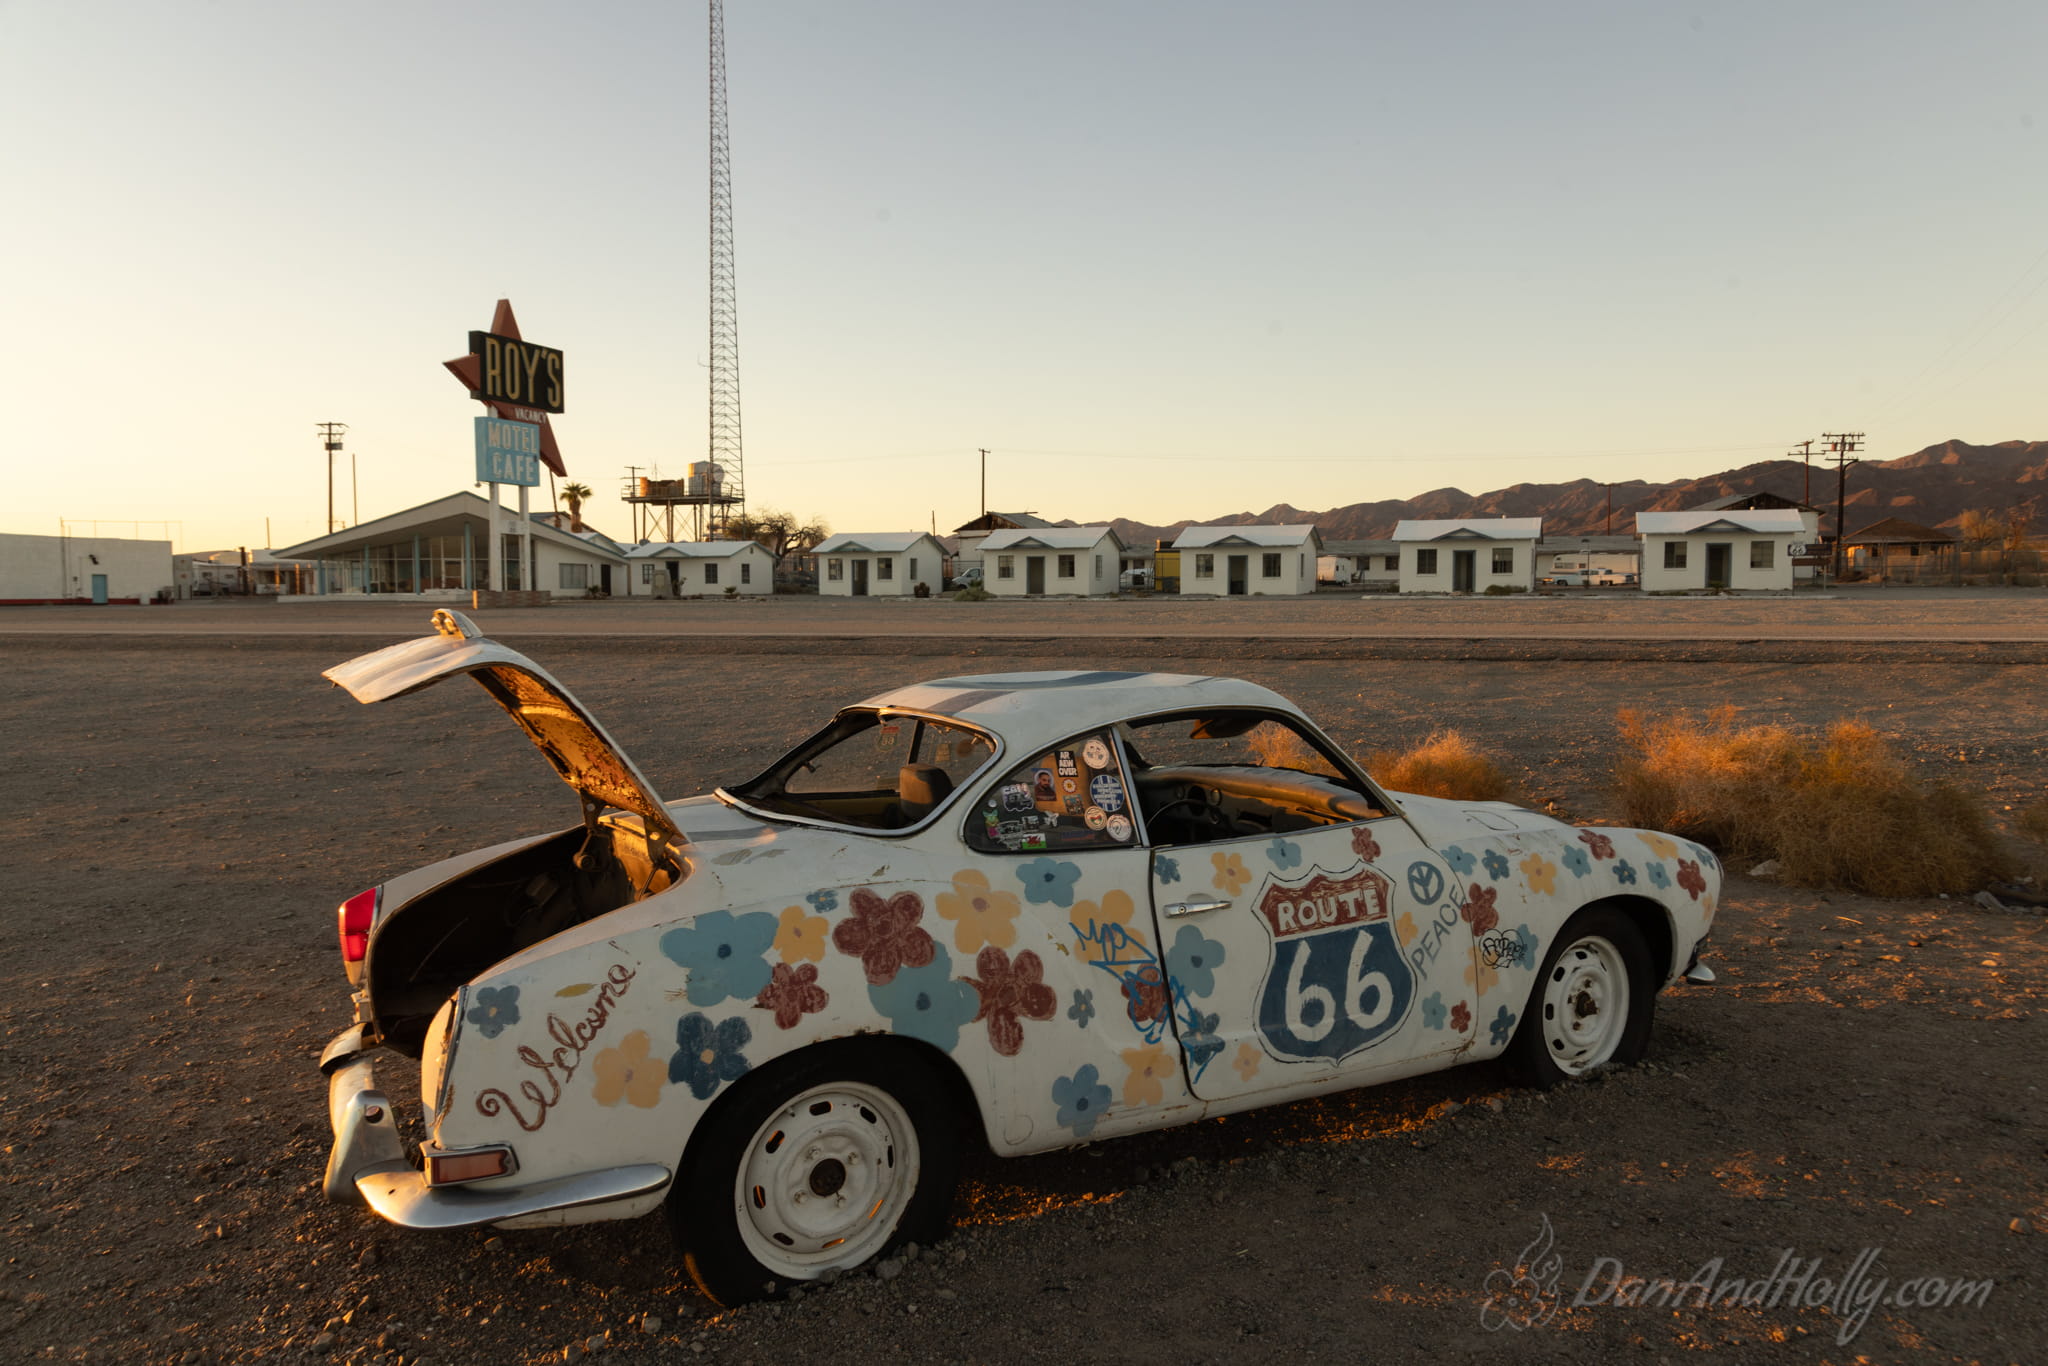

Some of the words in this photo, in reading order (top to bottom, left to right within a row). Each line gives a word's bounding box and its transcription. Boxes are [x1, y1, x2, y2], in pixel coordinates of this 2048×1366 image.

[486, 337, 561, 408] ROY'S
[514, 407, 547, 424] VACANCY
[487, 421, 537, 454] MOTEL
[492, 452, 535, 482] CAFE
[1277, 888, 1382, 931] ROUTE
[1411, 884, 1466, 981] PEACE
[1285, 929, 1394, 1043] 66
